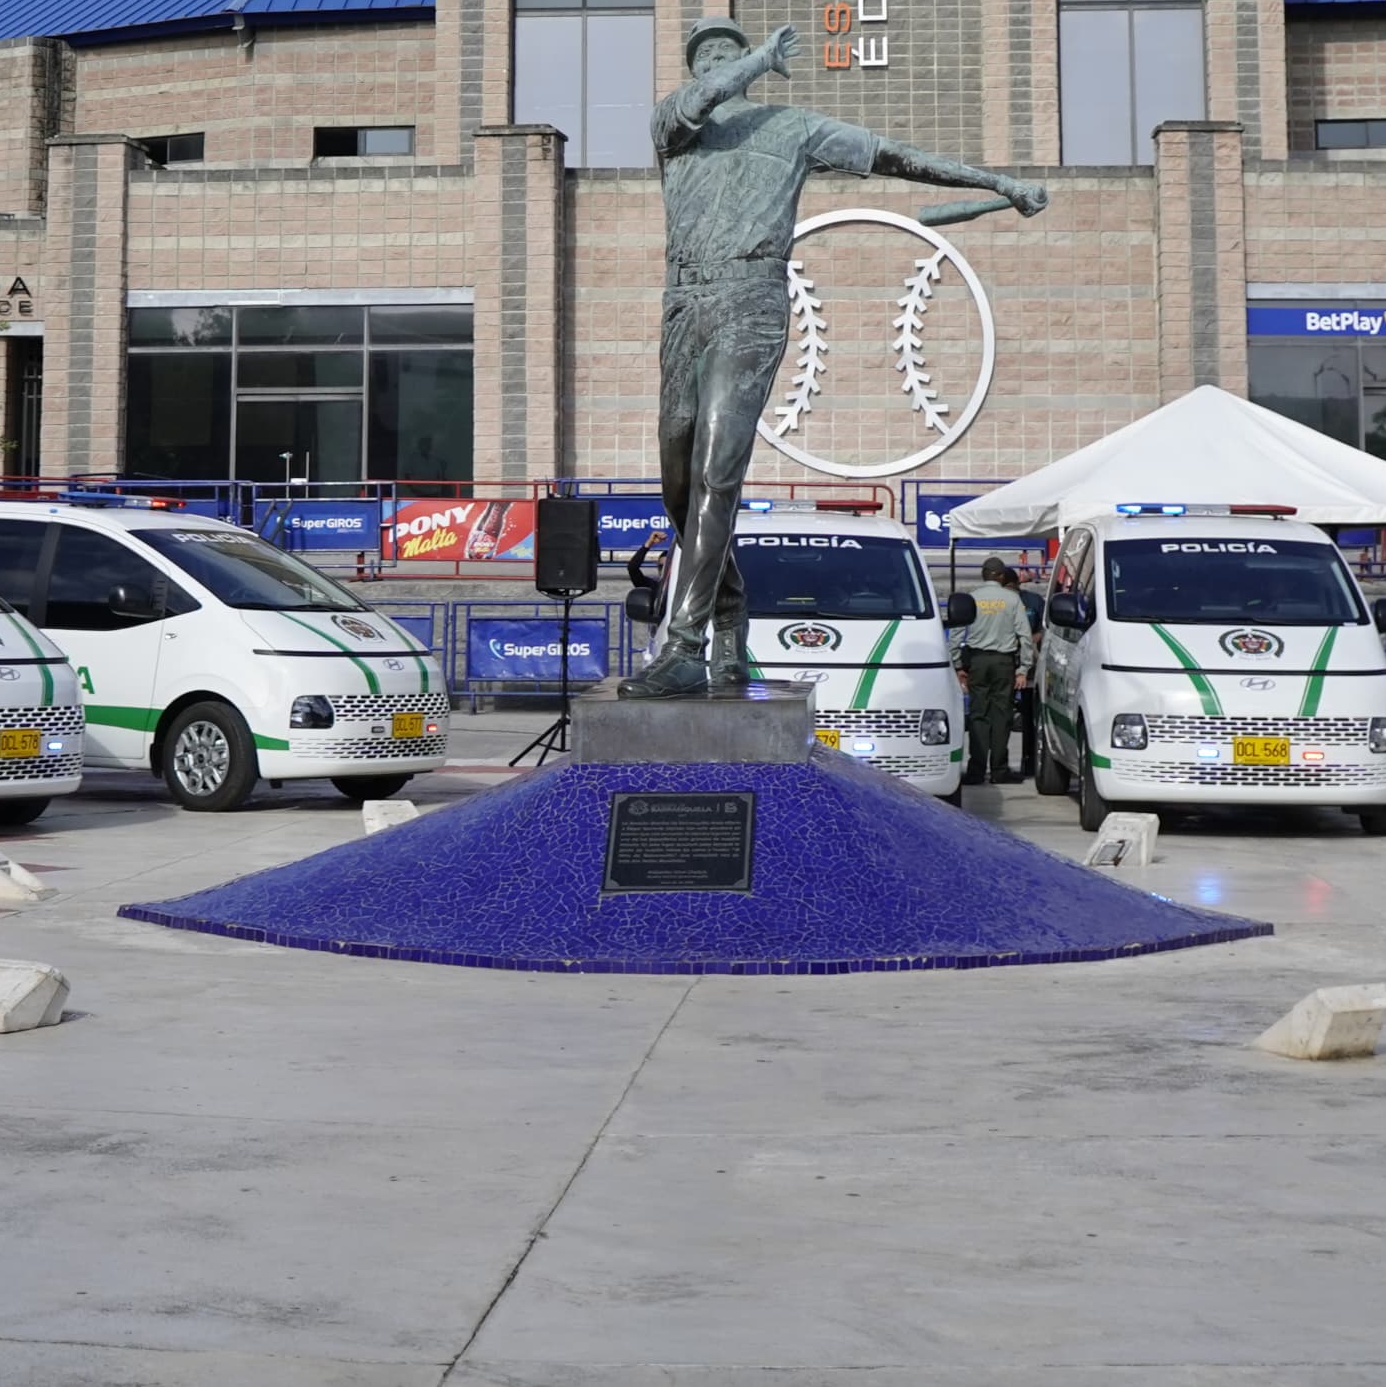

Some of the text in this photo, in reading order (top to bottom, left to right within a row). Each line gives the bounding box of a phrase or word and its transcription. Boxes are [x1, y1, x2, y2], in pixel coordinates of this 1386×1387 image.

[1305, 311, 1384, 335] BetPlay
[388, 502, 475, 544] PONY
[402, 528, 458, 559] Malta
[736, 536, 863, 550] POLICÍA
[1160, 541, 1278, 555] POLICÍA
